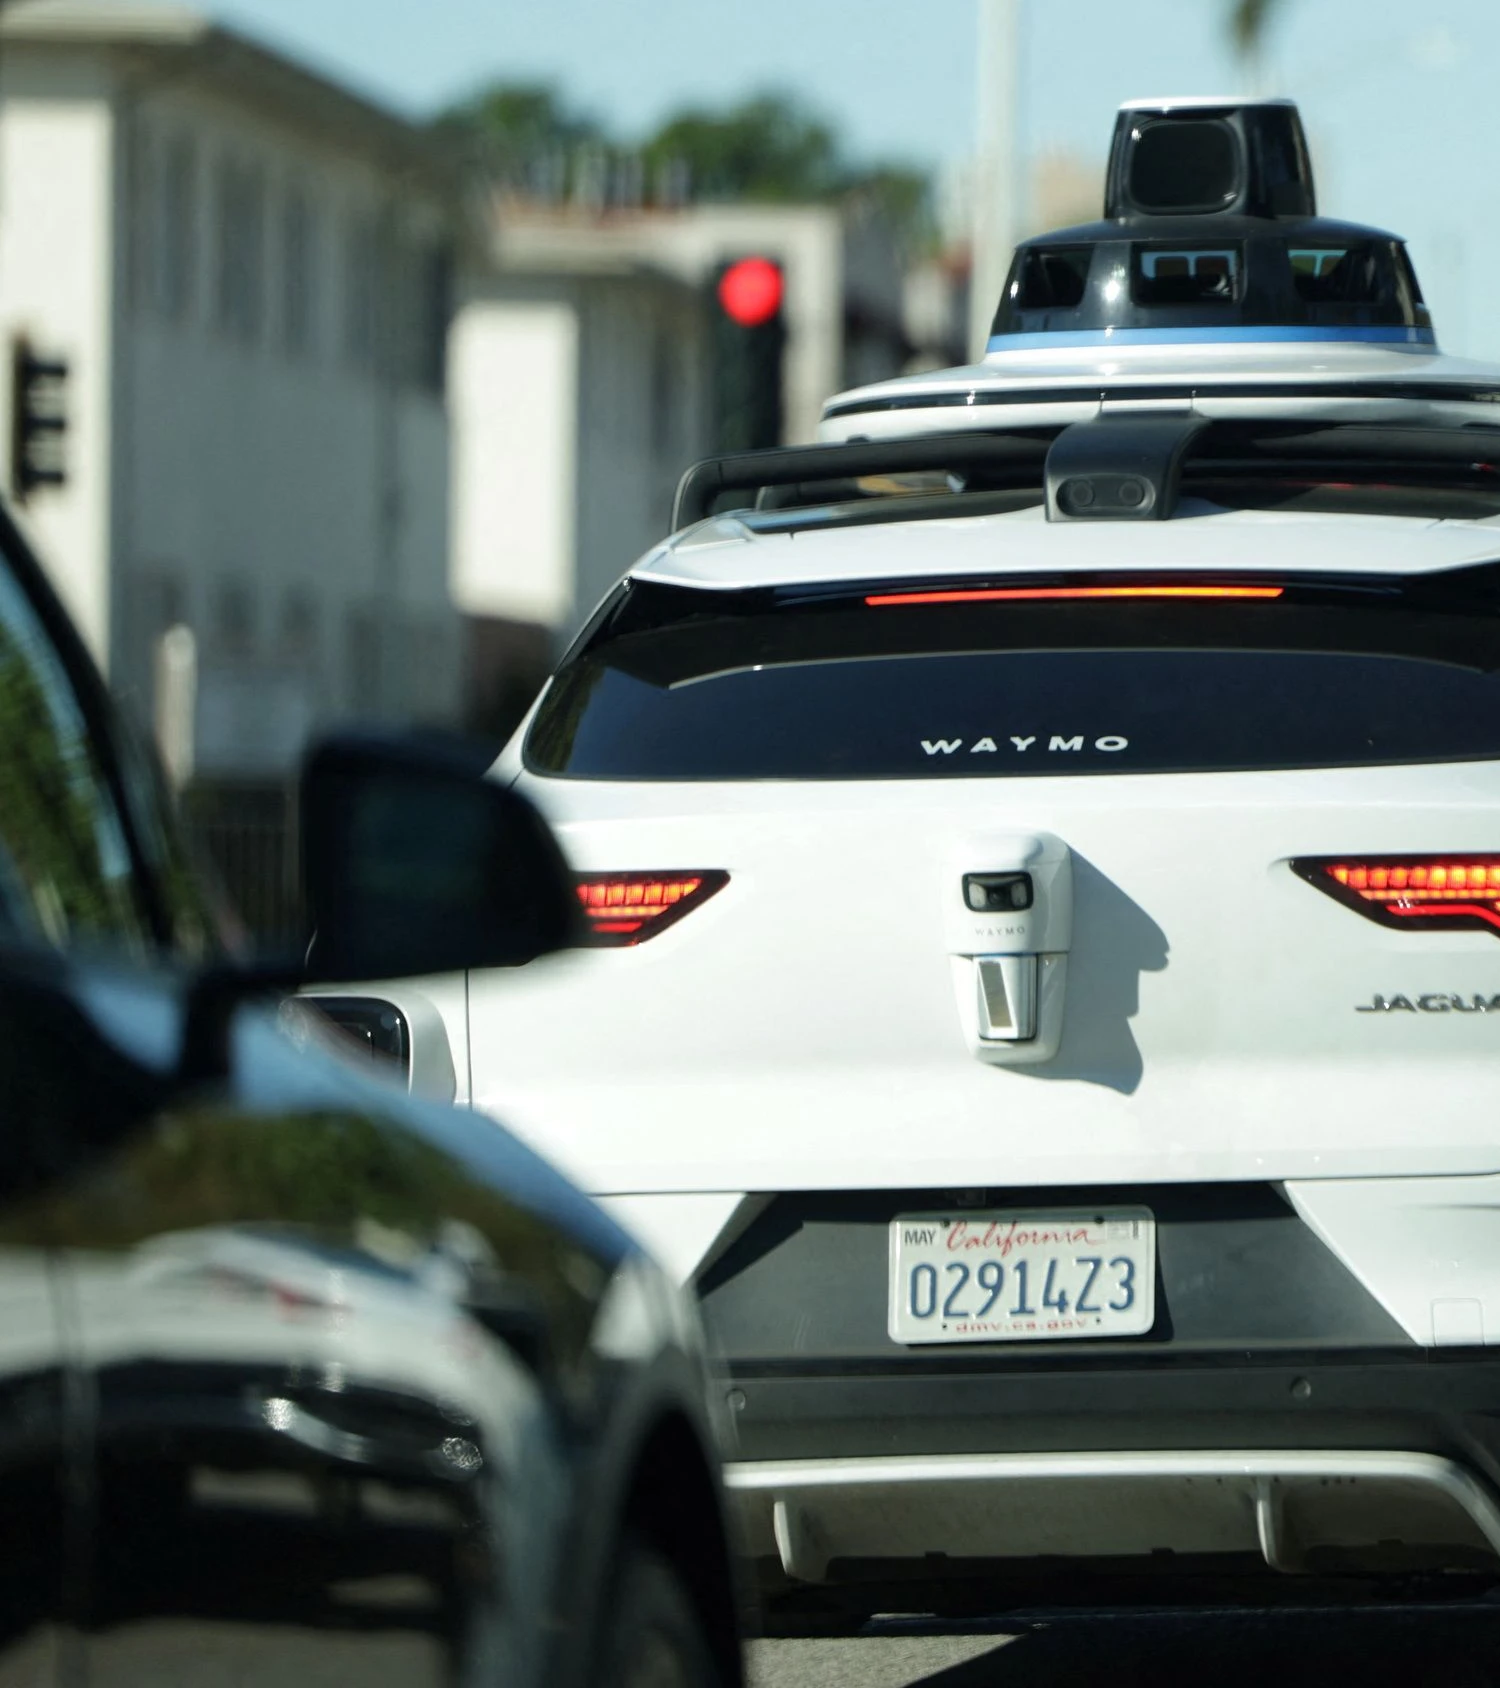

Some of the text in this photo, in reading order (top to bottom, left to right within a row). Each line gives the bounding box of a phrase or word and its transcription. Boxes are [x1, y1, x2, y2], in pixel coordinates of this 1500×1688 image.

[920, 735, 1129, 755] WAYMO
[974, 925, 1026, 936] WAYMO
[904, 1229, 936, 1246] MAY
[946, 1219, 1097, 1257] California
[910, 1256, 1136, 1320] 02914Z3
